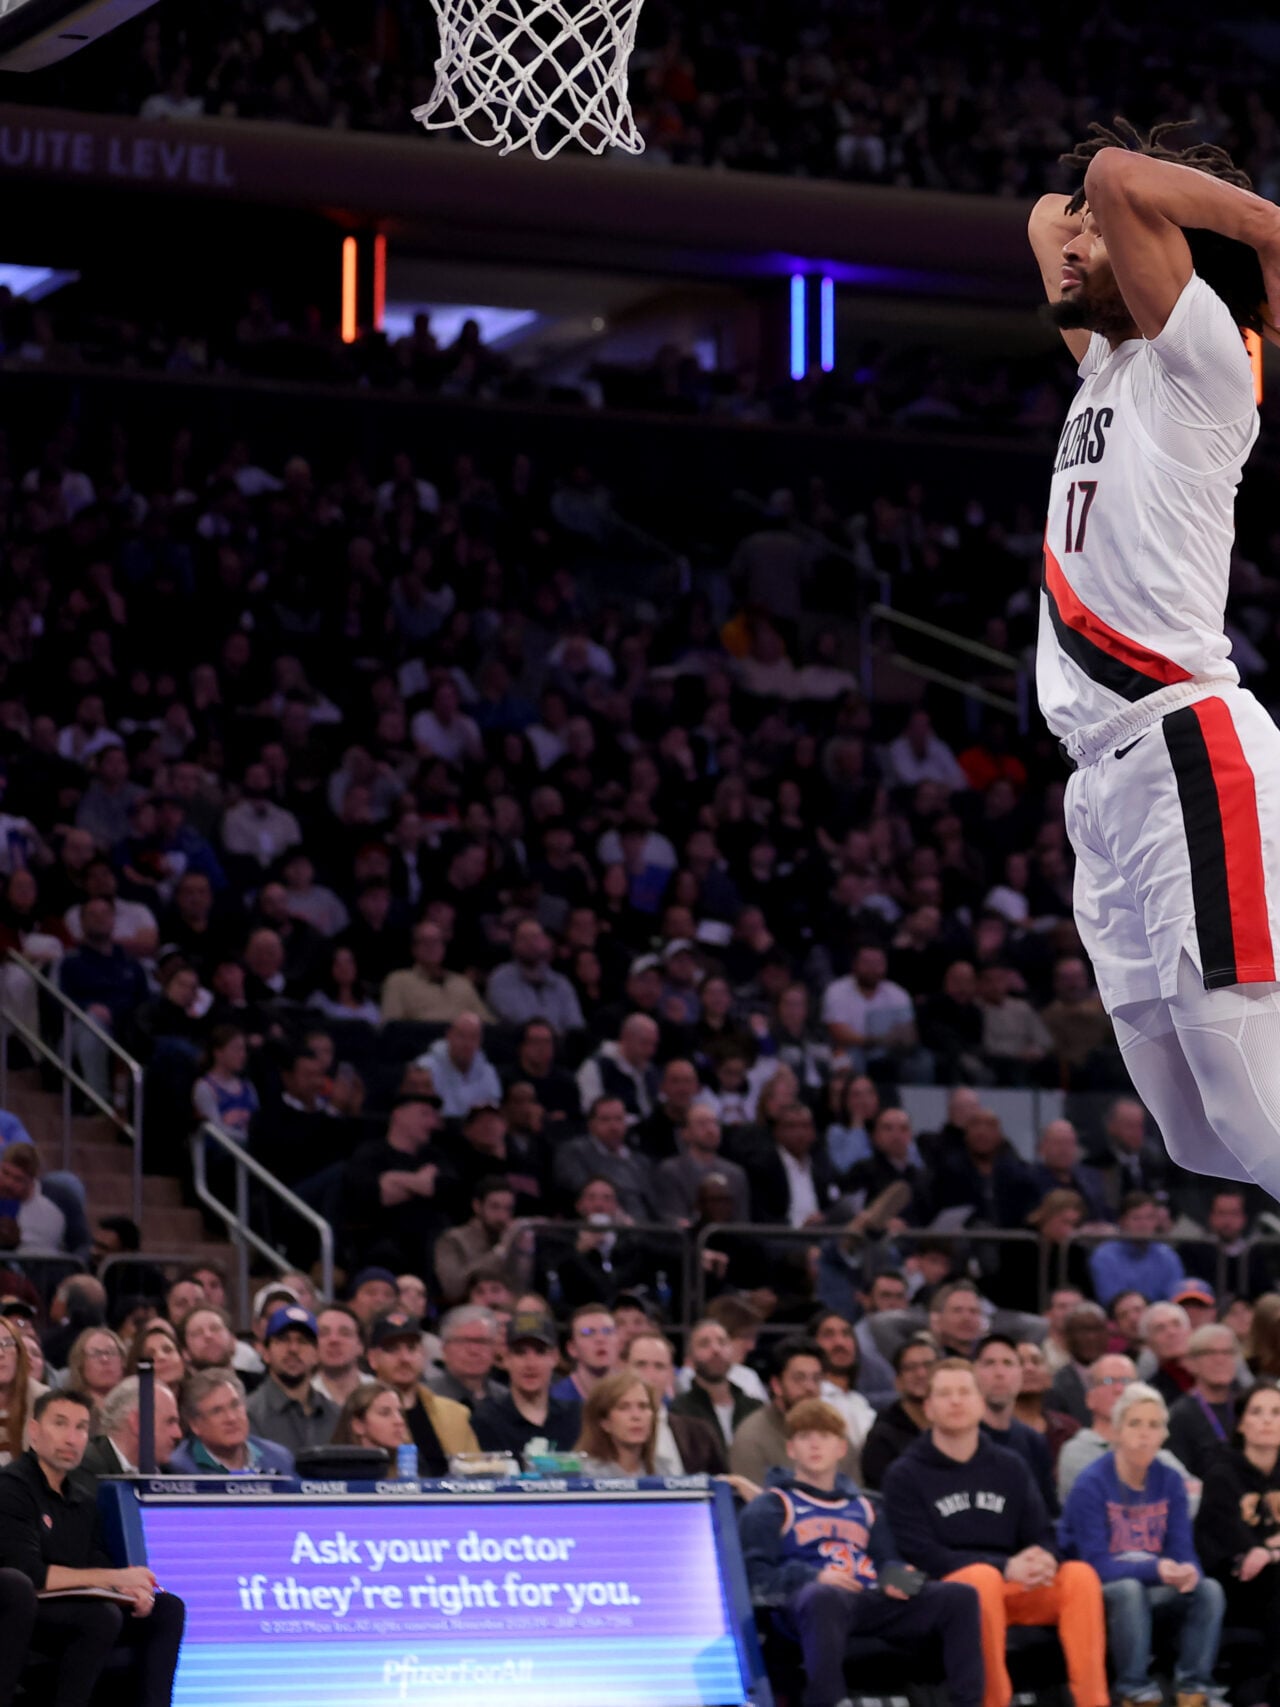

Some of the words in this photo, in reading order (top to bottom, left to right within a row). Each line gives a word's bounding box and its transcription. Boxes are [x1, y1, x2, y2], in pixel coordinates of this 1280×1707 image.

[0, 127, 93, 174] UITE
[108, 137, 233, 186] LEVEL
[1052, 407, 1113, 475] LAZERS
[1064, 481, 1098, 553] 17
[291, 1531, 361, 1564] Ask
[364, 1537, 450, 1572] your
[457, 1530, 575, 1563] doctor
[237, 1574, 267, 1611] if
[270, 1576, 403, 1617] they're
[408, 1575, 501, 1616] right
[502, 1572, 559, 1608] for
[565, 1579, 641, 1614] you.
[382, 1655, 534, 1699] PfizerForAll
